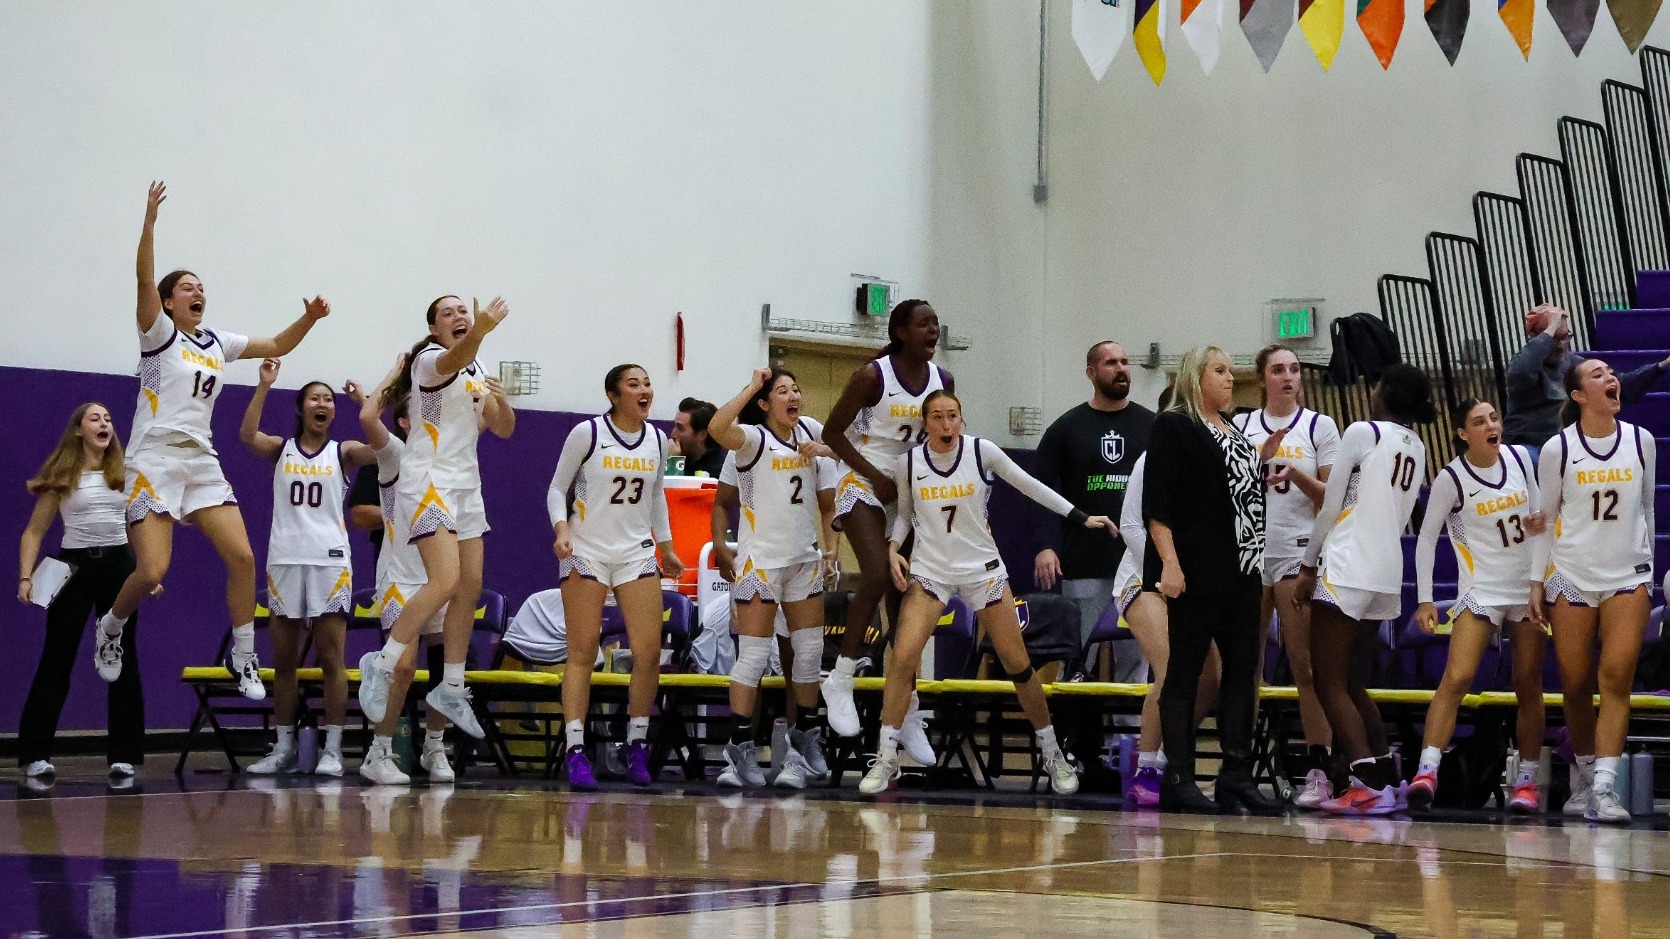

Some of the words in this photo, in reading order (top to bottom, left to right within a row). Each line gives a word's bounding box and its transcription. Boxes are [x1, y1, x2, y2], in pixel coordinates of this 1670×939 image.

[182, 349, 223, 370] REGAL
[192, 370, 216, 399] 14
[284, 463, 333, 476] REGALS
[603, 455, 655, 472] REGALS
[1391, 452, 1416, 491] 10
[1577, 467, 1633, 484] REGALS
[610, 476, 645, 505] 23
[790, 475, 804, 505] 2
[1087, 482, 1127, 491] OPPONE
[1106, 474, 1129, 483] HIDD
[290, 480, 323, 508] 00
[920, 482, 976, 500] REGALS
[1591, 489, 1618, 521] 12
[941, 505, 957, 533] 7
[1496, 514, 1524, 548] 13
[712, 581, 731, 592] GATO
